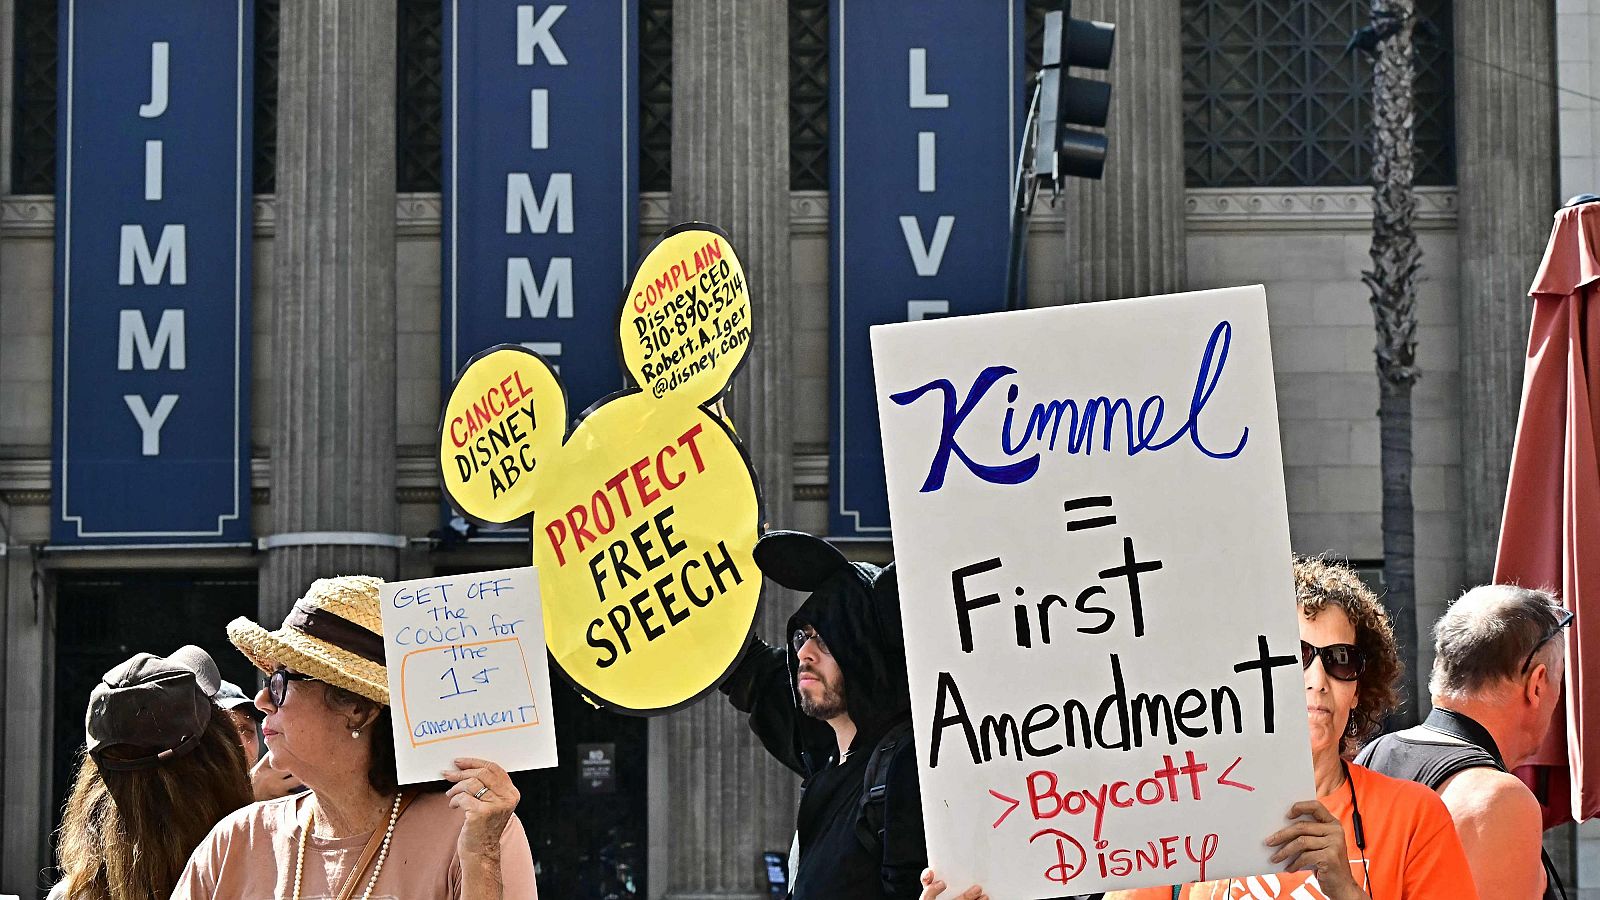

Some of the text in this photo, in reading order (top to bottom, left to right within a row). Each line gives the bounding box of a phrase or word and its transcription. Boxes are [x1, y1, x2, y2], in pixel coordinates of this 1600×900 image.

[118, 42, 186, 455] JIMMY
[633, 238, 722, 314] COMPLAIN
[633, 259, 730, 338] Disney CEO
[653, 326, 750, 399] @disney.com
[450, 370, 533, 448] CANCEL
[455, 399, 537, 482] DISNEY
[889, 320, 1249, 493] Kimmel
[489, 444, 536, 499] ABC
[545, 423, 706, 567] PROTECT
[393, 578, 515, 609] GET OFF
[588, 505, 687, 602] FREE
[952, 537, 1162, 653] First
[489, 614, 525, 636] for
[586, 541, 744, 668] SPEECH
[929, 635, 1297, 768] Amendment
[1026, 750, 1208, 841] Boycott
